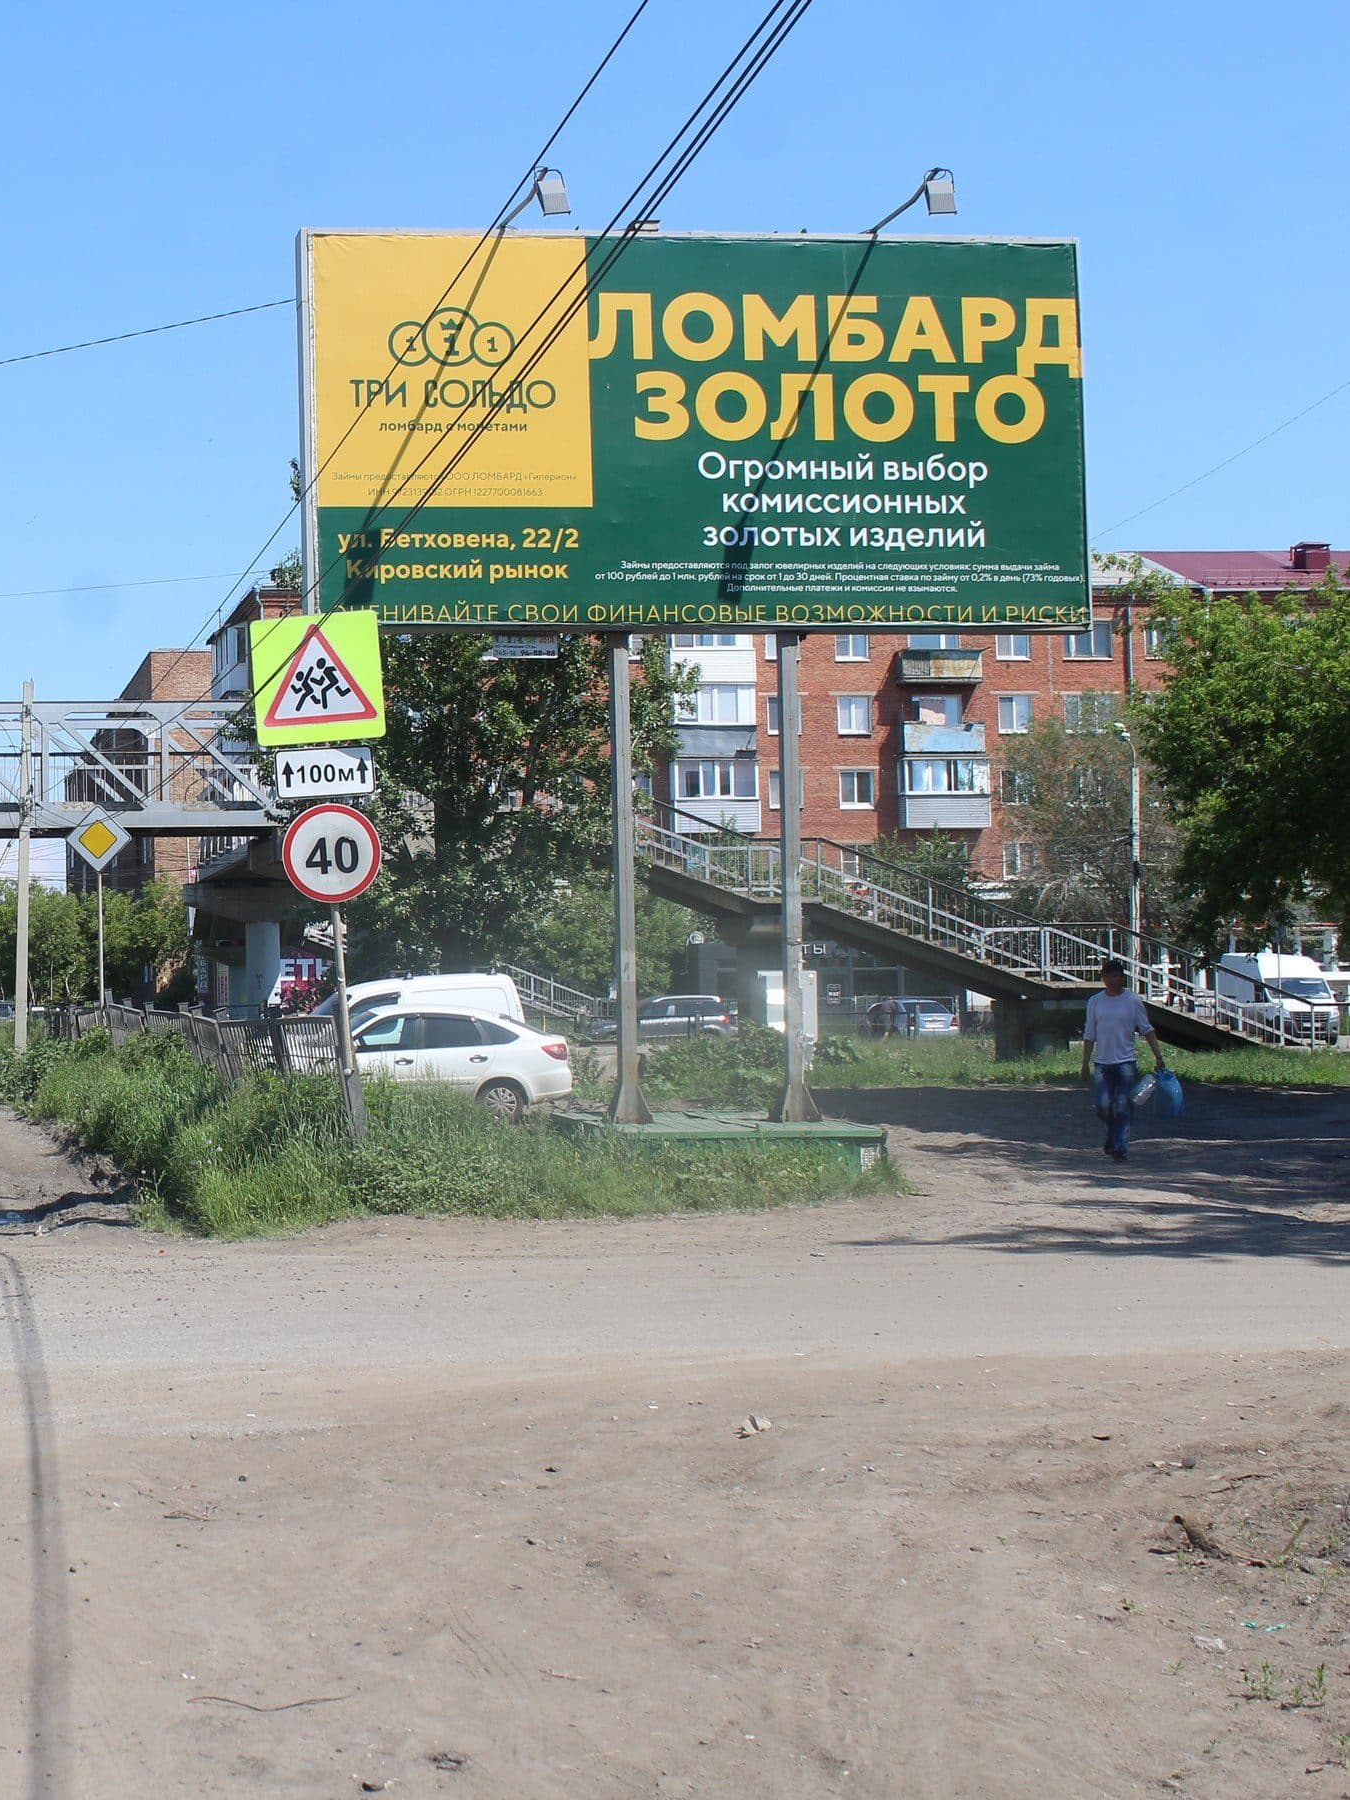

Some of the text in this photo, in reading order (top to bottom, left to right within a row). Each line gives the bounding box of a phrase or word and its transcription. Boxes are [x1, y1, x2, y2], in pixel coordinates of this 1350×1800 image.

[487, 336, 498, 352] 1
[588, 291, 1082, 379] ЛОМБАРД
[349, 379, 556, 414] ТРИ СОЛЬДО
[633, 370, 1046, 444] ЗОЛОТО
[378, 419, 443, 434] ломбард
[471, 472, 523, 482] ЛОМБАРД
[697, 451, 989, 488] Огромный выбор
[444, 487, 471, 497] ОГРН
[722, 493, 967, 515] комиссионных
[337, 528, 579, 554] ул. Бетховена, 22/2
[702, 520, 987, 552] золотых изделий
[346, 558, 570, 584] Кировский рынок
[620, 560, 650, 570] Займы
[651, 562, 730, 571] предоставляются
[731, 563, 748, 571] под
[775, 563, 826, 571] ювелирных
[827, 561, 865, 571] изделий
[877, 563, 928, 572] следующих
[972, 564, 1000, 572] сумма
[1000, 564, 1033, 572] выдачи
[1033, 562, 1060, 571] займа
[607, 571, 624, 580] 100
[625, 572, 658, 582] рублей
[677, 573, 697, 581] млн.
[698, 572, 730, 582] рублей
[744, 574, 766, 582] срок
[782, 574, 795, 582] до
[795, 572, 809, 581] 30
[809, 572, 834, 582] дней.
[834, 572, 889, 583] Процентная
[932, 573, 959, 583] займу
[970, 572, 993, 583] 0,2%
[1022, 573, 1043, 584] (73%
[725, 583, 804, 592] Дополнительные
[334, 600, 1088, 623] НИВАЙТЕ СВОИ ФИНАНСОВЫЕ ВОЗМОЖНОСТИ И РИСКИ
[296, 763, 355, 784] 100м
[305, 836, 359, 875] 40
